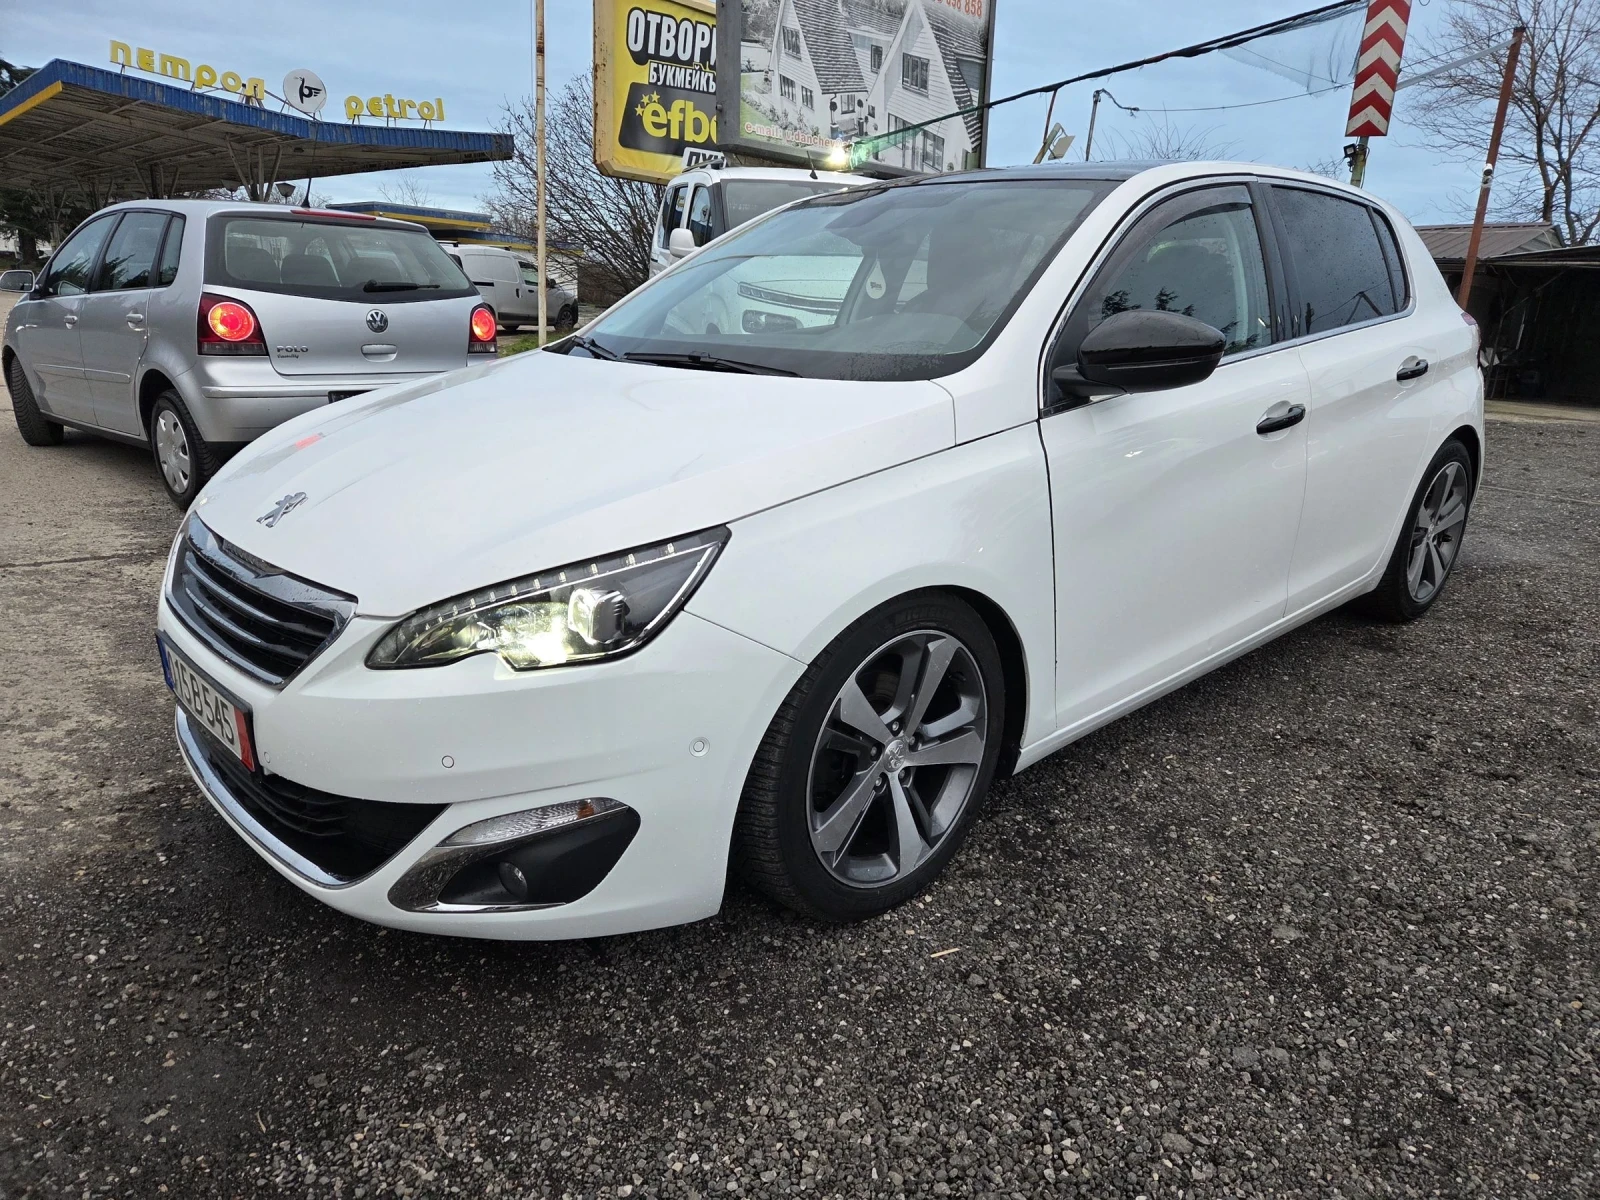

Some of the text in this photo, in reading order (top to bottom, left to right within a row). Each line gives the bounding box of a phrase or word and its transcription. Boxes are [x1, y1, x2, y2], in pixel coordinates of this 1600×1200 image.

[344, 93, 444, 121] petrol
[642, 99, 716, 144] efb
[277, 345, 309, 353] POLO
